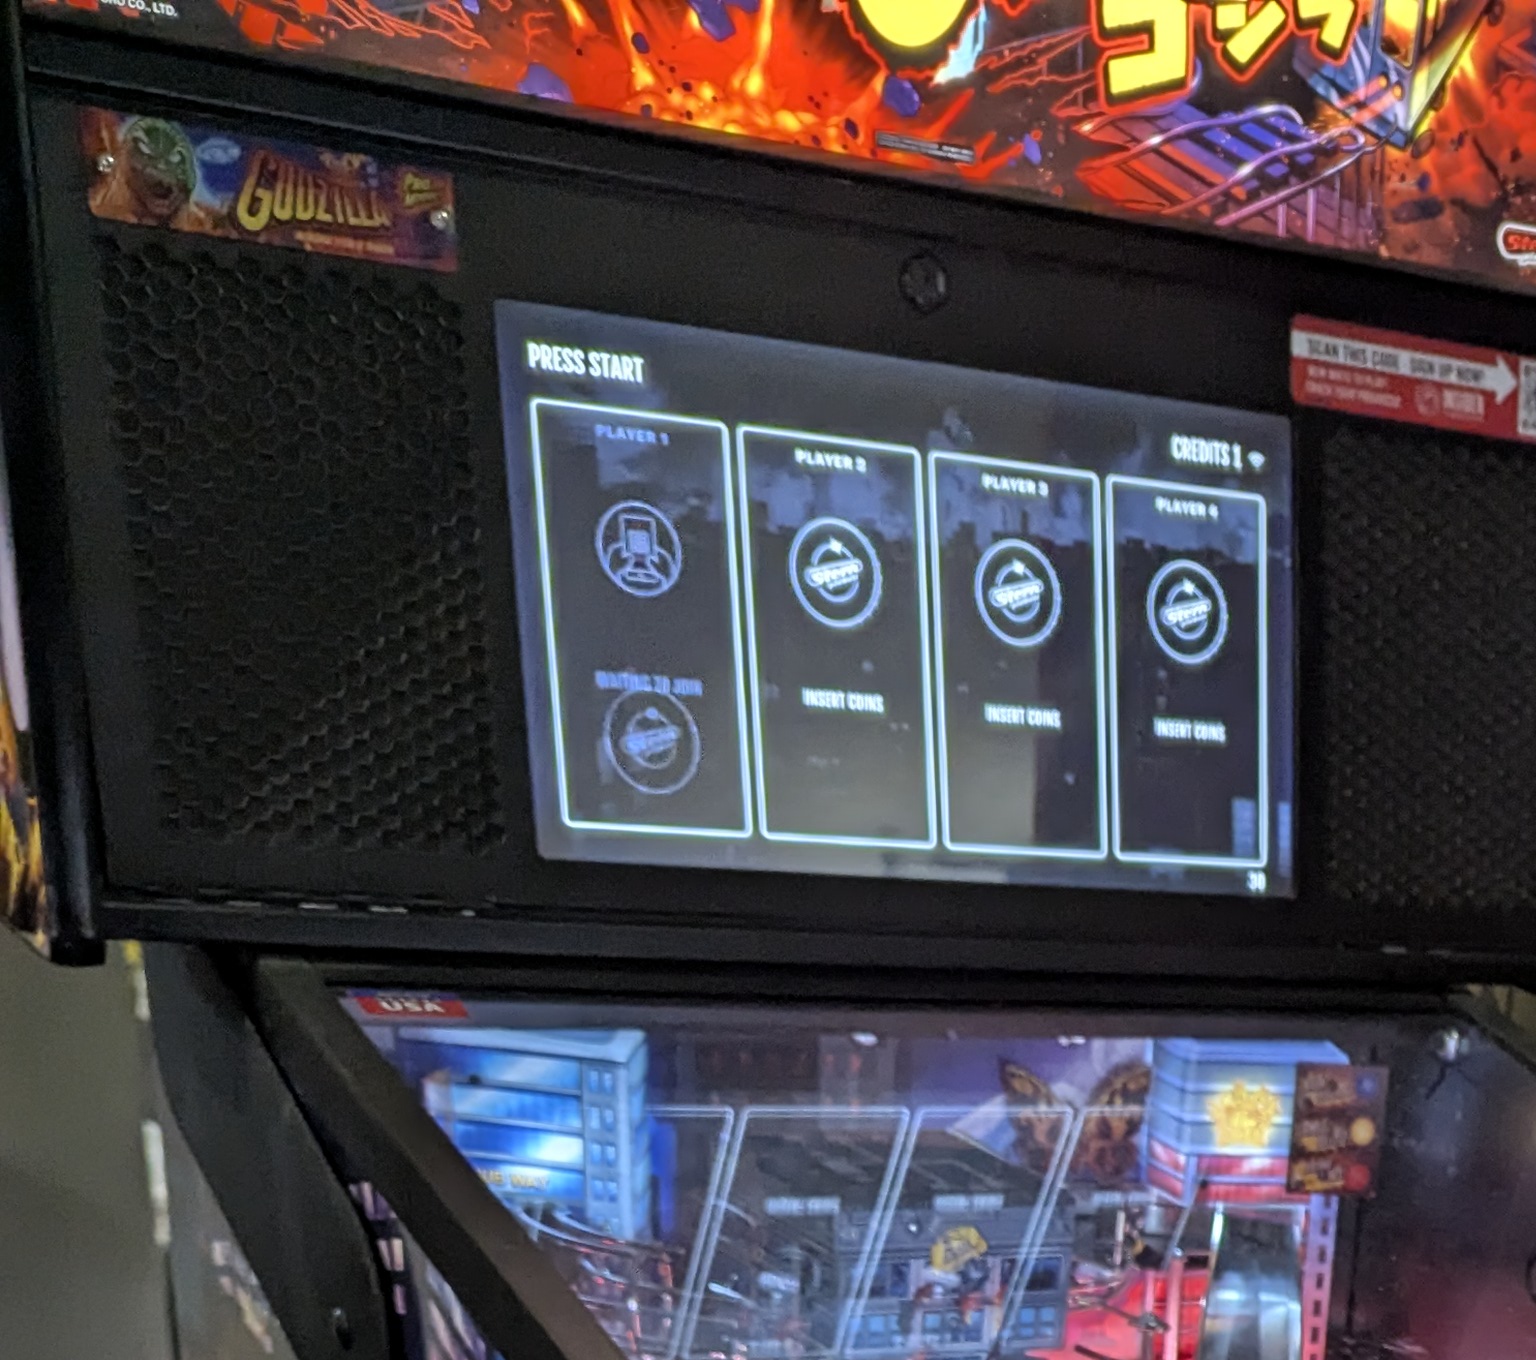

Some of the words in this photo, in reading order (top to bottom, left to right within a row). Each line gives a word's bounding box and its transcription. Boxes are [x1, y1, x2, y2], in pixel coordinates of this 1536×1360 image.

[152, 2, 177, 17] LTD.
[236, 150, 392, 232] GODZILLA
[526, 342, 586, 376] PRESS
[588, 351, 645, 384] START
[594, 424, 656, 444] PLAYER
[658, 433, 670, 446] 1
[794, 447, 853, 471] PLAYER
[855, 458, 867, 473] 2
[1171, 433, 1231, 466] CREDITS
[1231, 444, 1243, 470] 1
[981, 473, 1036, 495] PLAYER
[1155, 496, 1206, 517] PLAYER
[802, 687, 846, 709] INSERT
[847, 691, 885, 713] COINS
[984, 703, 1025, 726] INSERT
[1027, 708, 1062, 731] COINS
[1153, 717, 1193, 740] INSERT
[1194, 722, 1227, 744] COINS
[1247, 870, 1267, 892] 30
[379, 998, 444, 1014] USA
